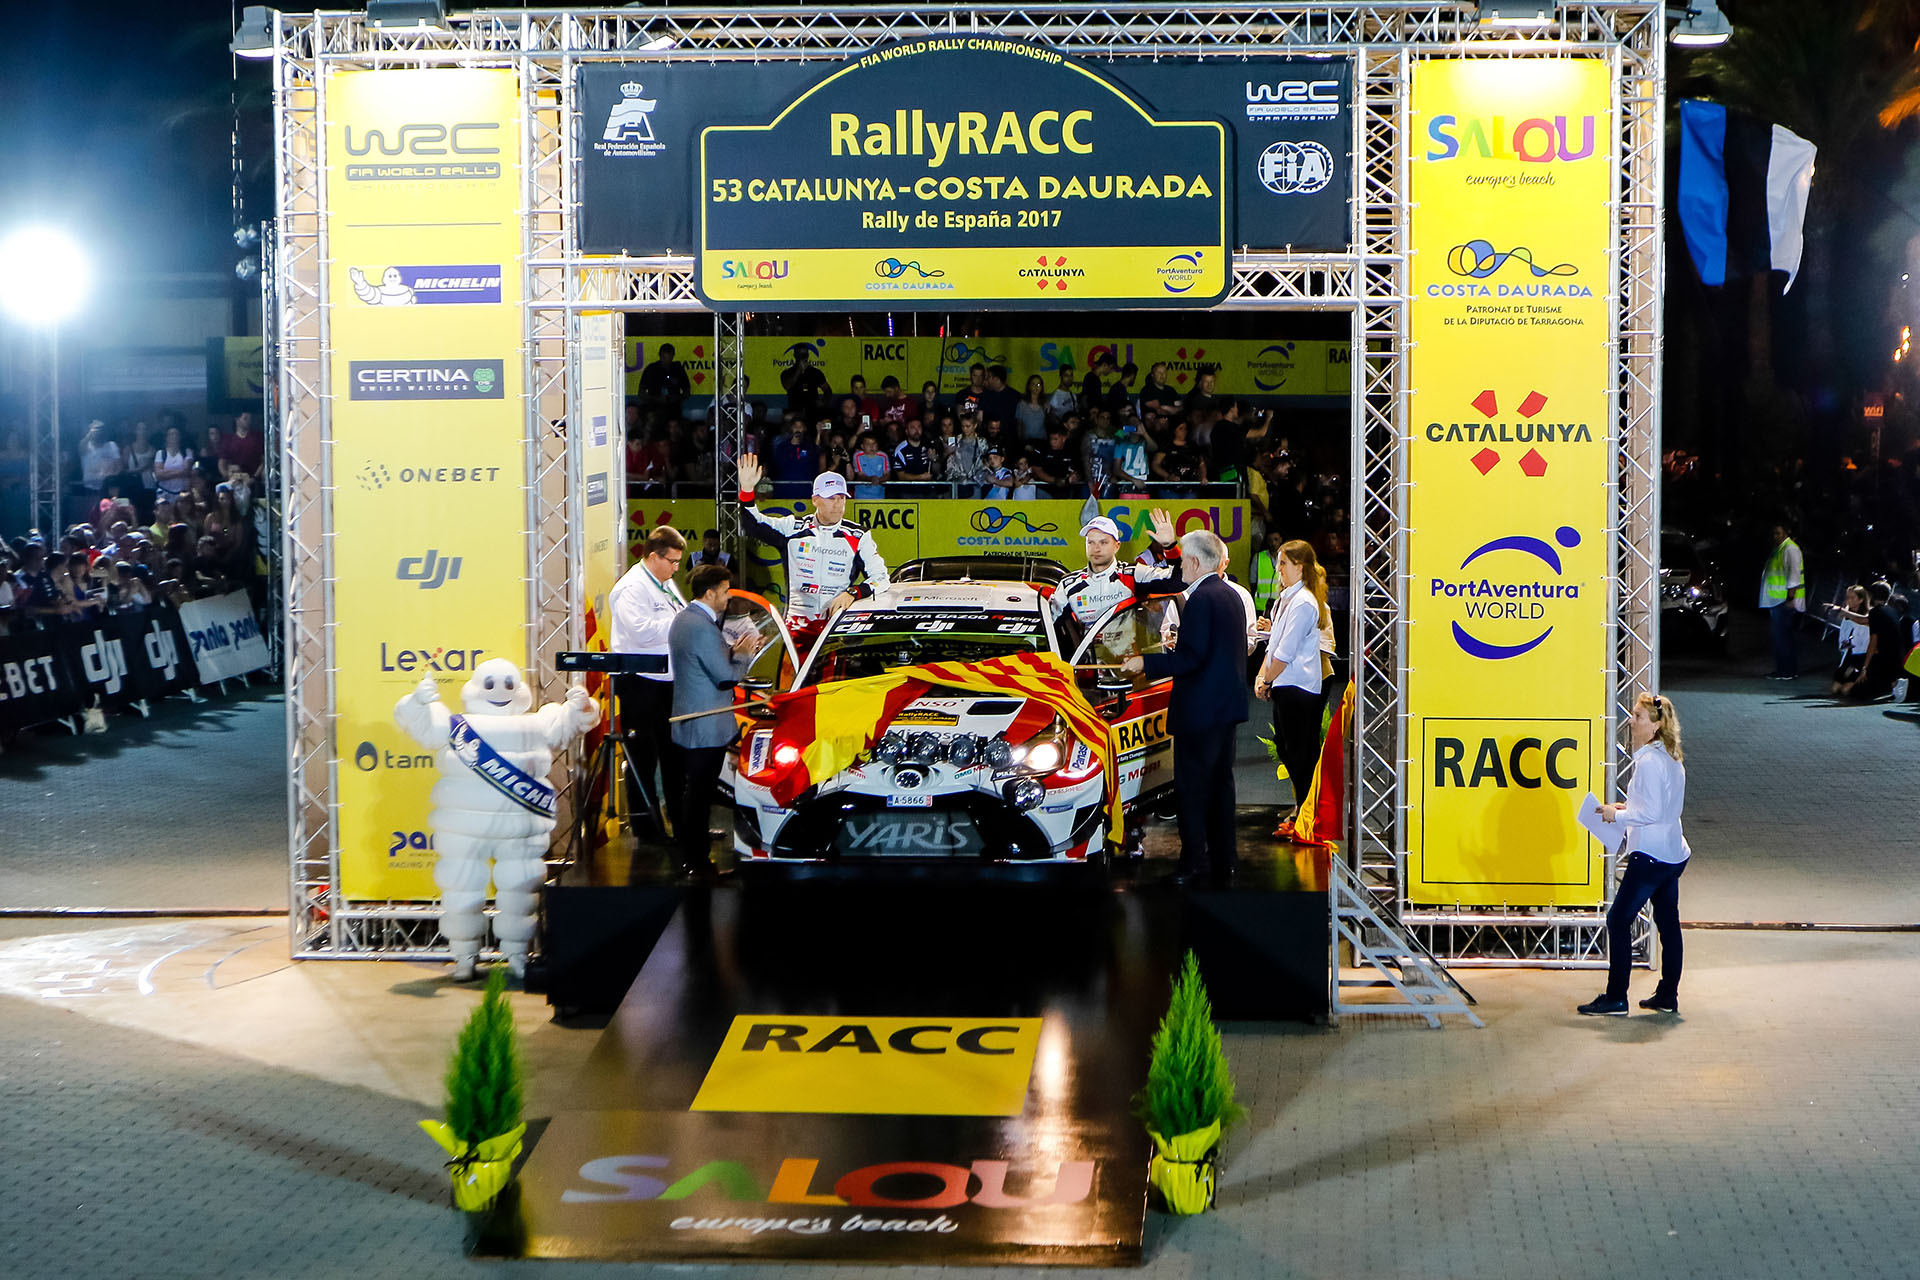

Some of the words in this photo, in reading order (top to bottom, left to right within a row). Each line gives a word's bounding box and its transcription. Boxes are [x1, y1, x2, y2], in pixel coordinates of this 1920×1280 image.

[860, 54, 881, 68] FIA
[883, 42, 926, 61] WORLD
[928, 38, 966, 51] RALLY
[967, 38, 1063, 65] CHAMPIONSHIP
[1246, 80, 1339, 102] WRC
[345, 122, 500, 156] WRC
[594, 142, 606, 150] Real
[830, 109, 1093, 168] RallyRACC
[1427, 114, 1595, 163] SALOU
[603, 149, 612, 157] de
[349, 168, 373, 177] FIA
[377, 167, 436, 177] WORLD
[440, 165, 497, 176] RALLY
[1519, 171, 1556, 186] beach
[712, 178, 743, 202] 53
[1039, 174, 1213, 199] DAURADA
[862, 210, 909, 233] Rally
[915, 210, 938, 228] de
[944, 209, 1012, 232] España
[1017, 210, 1062, 228] 2017
[721, 260, 789, 280] SALOU
[1018, 268, 1085, 277] CATALUNYA
[1157, 267, 1203, 275] PortAventura
[414, 277, 501, 289] MICHELIN
[865, 282, 900, 291] COSTA
[902, 282, 954, 291] DAURADA
[1427, 284, 1491, 297] COSTA
[1498, 284, 1593, 297] DAURADA
[1466, 305, 1511, 313] PATRONAT
[1526, 305, 1562, 313] TURISME
[1470, 316, 1515, 325] DIPUTACIÓ
[1531, 317, 1584, 325] TARRAGONA
[864, 343, 905, 361] RACC
[357, 368, 470, 383] CERTINA
[1425, 422, 1592, 444] CATALUNYA
[400, 467, 500, 483] ONEBET
[859, 509, 915, 530] RACC
[957, 536, 1000, 546] COSTA
[1004, 536, 1068, 546] DAURADA
[811, 545, 848, 557] Microsoft
[1089, 591, 1123, 603] Microsoft
[1431, 578, 1579, 599] PortAventura
[992, 614, 1041, 623] Racing
[1465, 601, 1545, 620] WORLD
[381, 642, 485, 672] Lexar
[1119, 714, 1165, 751] RACC
[1128, 760, 1161, 782] MORI
[1434, 737, 1579, 790] RACC
[954, 770, 973, 780] DMG
[741, 1024, 1021, 1056] RACC
[561, 1155, 1097, 1209] SALOU
[670, 1213, 832, 1235] europe's
[840, 1212, 958, 1235] beach
